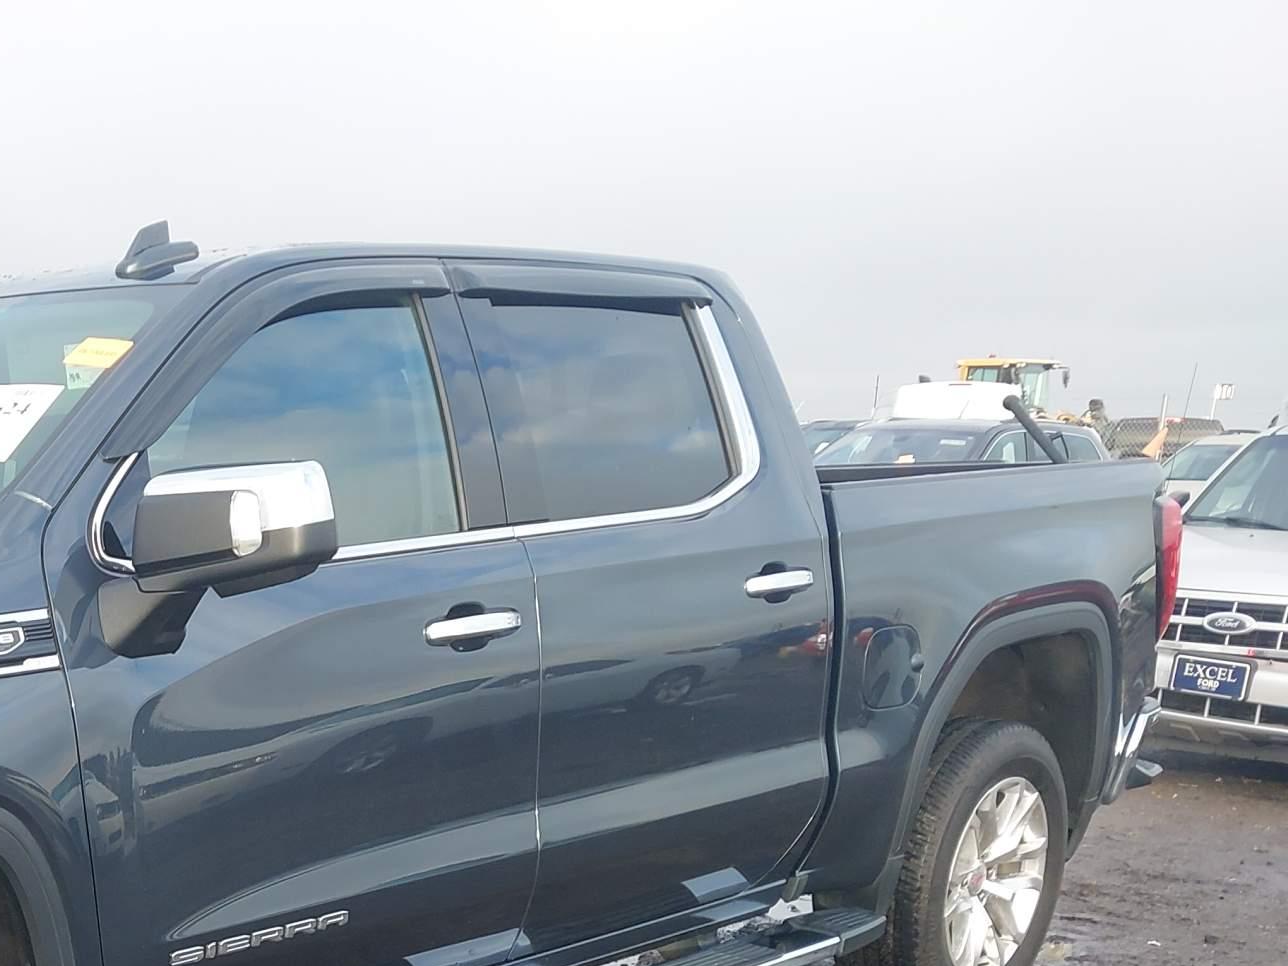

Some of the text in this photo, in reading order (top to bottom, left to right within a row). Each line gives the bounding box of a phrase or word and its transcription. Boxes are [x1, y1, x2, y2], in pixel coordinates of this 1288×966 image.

[1214, 617, 1241, 629] Ford
[1184, 662, 1238, 683] EXCEL
[1196, 678, 1220, 689] FORD
[169, 910, 350, 966] SIERRA
